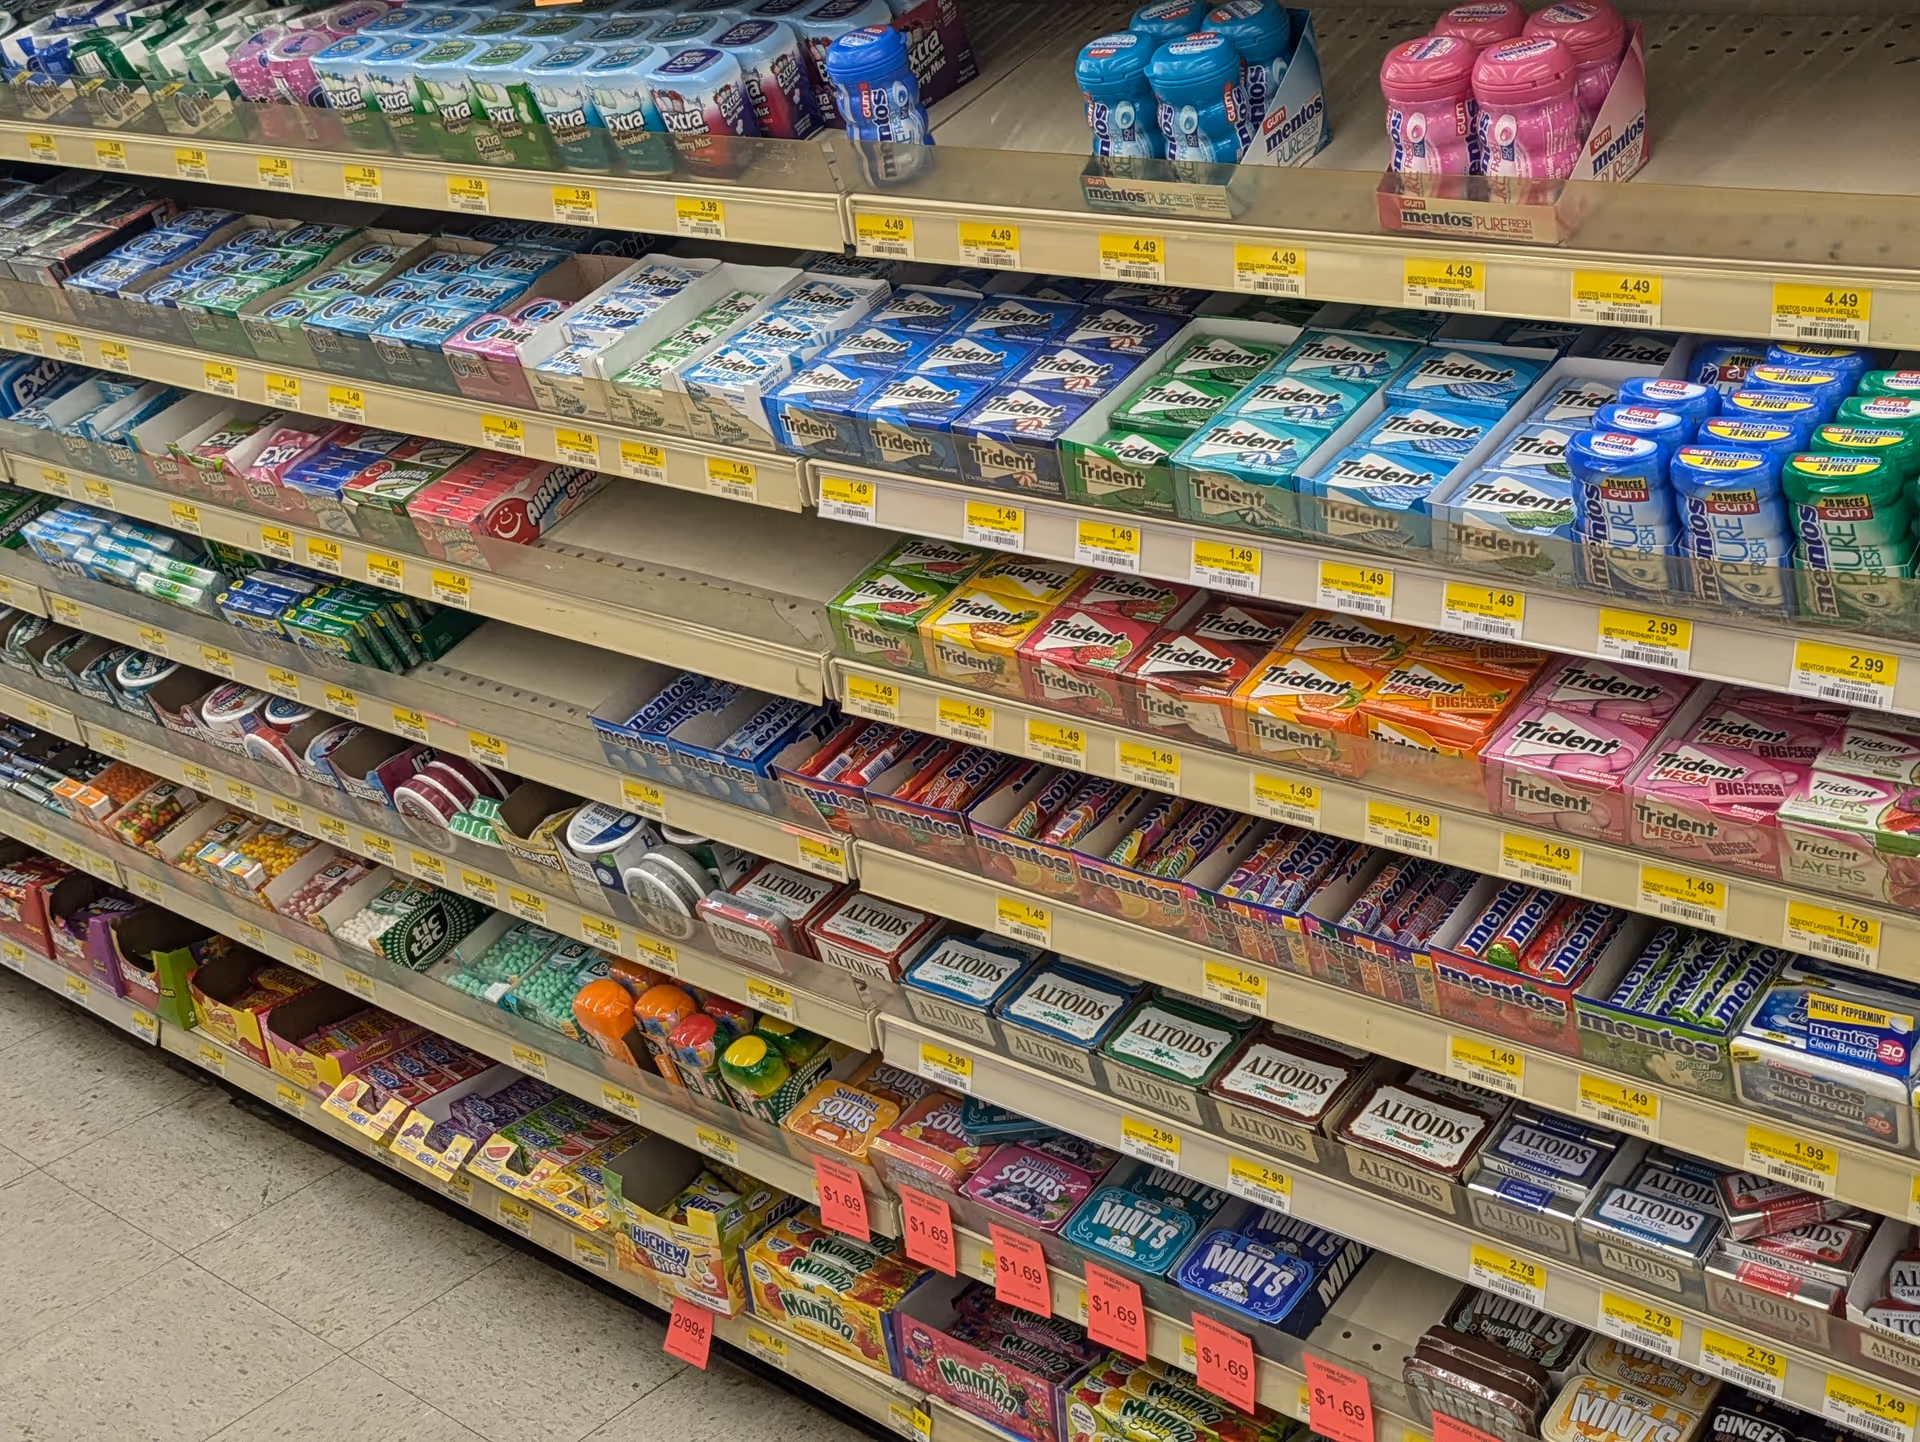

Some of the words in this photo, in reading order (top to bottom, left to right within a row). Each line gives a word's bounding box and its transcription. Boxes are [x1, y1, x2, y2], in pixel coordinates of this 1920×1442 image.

[547, 109, 585, 128] Extra
[605, 111, 644, 133] Extra
[663, 110, 703, 131] Extra
[1266, 96, 1323, 152] mentos
[1592, 117, 1645, 174] mentos
[362, 168, 375, 178] 3.99
[469, 180, 482, 190] 3.99
[575, 190, 590, 200] 3.99
[701, 202, 717, 212] 3.99
[1402, 210, 1472, 227] mentos
[1476, 216, 1508, 232] PURE
[1508, 219, 1532, 228] FRESH
[991, 229, 1011, 241] 4.49
[1134, 241, 1155, 253] 4.49
[1272, 252, 1296, 264] 4.49
[632, 274, 690, 289] Trident
[1445, 265, 1472, 278] 4.49
[1620, 279, 1650, 293] 4.49
[1825, 292, 1858, 307] 4.49
[583, 314, 613, 325] WHITE
[585, 304, 646, 320] Trident
[701, 366, 733, 379] WHITE
[705, 355, 767, 374] Trident
[577, 434, 592, 443] 1.49
[642, 446, 658, 456] 1.49
[377, 470, 430, 483] AIRHEADS
[567, 468, 597, 499] gum
[1605, 479, 1617, 489] 28
[1617, 479, 1643, 489] PIECES
[1712, 492, 1723, 502] 28
[1724, 491, 1753, 502] PIECES
[1823, 498, 1834, 507] 28
[1835, 497, 1865, 507] PIECES
[906, 542, 973, 562] Trident
[1229, 548, 1252, 562] 1.49
[1719, 516, 1749, 576] PURE
[1750, 537, 1768, 576] FRESH
[1837, 523, 1862, 586] PURE
[1868, 545, 1886, 585] FRESH
[1359, 570, 1384, 585] 1.49
[857, 580, 928, 603] Trident
[1488, 592, 1514, 607] 1.49
[949, 598, 1023, 625] Trident
[1047, 619, 1125, 647] Trident
[1202, 613, 1284, 639] Trident
[1310, 620, 1395, 647] Trident
[1604, 626, 1624, 635] MENTOS
[1625, 629, 1654, 640] FRESHMINT
[1647, 620, 1677, 636] 2.99
[1151, 643, 1234, 670] Trident
[1850, 656, 1884, 673] 2.99
[1264, 665, 1352, 693] Trident
[1800, 662, 1823, 672] MENTOS
[1825, 666, 1857, 677] SPEARMINT
[1561, 668, 1663, 700] Trident
[626, 675, 695, 729] mentos
[967, 705, 985, 718] 1.49
[1435, 696, 1459, 708] BIG
[597, 726, 668, 757] mentos
[1059, 729, 1079, 741] 1.49
[1516, 720, 1621, 754] Trident
[1699, 731, 1753, 749] MEGA
[1701, 716, 1788, 744] Trident
[678, 750, 755, 784] mentos
[1152, 751, 1173, 764] 1.49
[1656, 752, 1745, 779] Trident
[1828, 748, 1904, 769] LAYERS
[1658, 768, 1710, 786] MEGA
[1290, 783, 1313, 798] 1.49
[1715, 782, 1743, 796] BIG
[1793, 792, 1870, 815] LAYERS
[876, 804, 962, 840] mentos
[1405, 811, 1430, 827] 1.49
[1645, 826, 1696, 845] MEGA
[522, 848, 562, 871] BREAKERS
[976, 831, 1070, 874] mentos
[1544, 844, 1571, 860] 1.49
[1789, 856, 1866, 882] LAYERS
[754, 872, 821, 904] ALTOIDS
[1685, 878, 1714, 894] 1.49
[527, 893, 541, 905] 2.99
[412, 912, 440, 937] tic
[602, 921, 615, 933] 2.99
[840, 903, 913, 936] ALTOIDS
[1838, 916, 1869, 933] 1.79
[410, 930, 447, 957] tac
[657, 942, 671, 954] 2.99
[121, 961, 158, 993] Skittles
[932, 949, 1009, 982] ALTOIDS
[1438, 964, 1567, 1017] mentos
[1028, 984, 1109, 1021] ALTOIDS
[1811, 1001, 1839, 1015] INTENSE
[1841, 1006, 1886, 1024] PEPPERMINT
[1131, 1018, 1219, 1058] ALTOIDS
[1578, 1008, 1719, 1062] mentos
[1809, 1022, 1879, 1048] mentos
[1490, 1048, 1515, 1065] 1.49
[1809, 1037, 1836, 1050] Clean
[1837, 1043, 1877, 1062] Breath
[1241, 1056, 1333, 1096] ALTOIDS
[833, 1086, 881, 1113] Sunkist
[1621, 1088, 1647, 1106] 1.49
[1769, 1070, 1867, 1106] mentos
[1769, 1084, 1808, 1102] Clean
[1809, 1091, 1866, 1119] Breath
[811, 1097, 877, 1133] SOURS
[1369, 1099, 1469, 1144] ALTOIDS
[1509, 1127, 1592, 1165] ALTOIDS
[1794, 1142, 1823, 1160] 1.99
[1020, 1155, 1070, 1183] Sunkist
[1262, 1168, 1284, 1184] 2.99
[995, 1164, 1066, 1202] SOURS
[823, 1185, 861, 1212] $1.69
[1609, 1192, 1699, 1232] ALTOIDS
[910, 1216, 948, 1245] $1.69
[1092, 1199, 1182, 1250] MINTS
[631, 1223, 690, 1267] HI-CHEW
[651, 1255, 686, 1277] bites
[789, 1256, 854, 1294] Mamba
[1000, 1255, 1042, 1284] $1.69
[1203, 1243, 1294, 1296] MINTS
[1510, 1259, 1535, 1277] 2.79
[778, 1292, 854, 1342] Mamba
[1092, 1294, 1138, 1325] $1.69
[1645, 1310, 1671, 1327] 2.79
[673, 1313, 706, 1341] 2/99¢
[1480, 1319, 1536, 1345] CHOCOLATE
[1202, 1346, 1249, 1381] $1.69
[1747, 1347, 1775, 1366] 2.79
[1315, 1387, 1365, 1422] $1.69
[1875, 1393, 1905, 1413] 1.49
